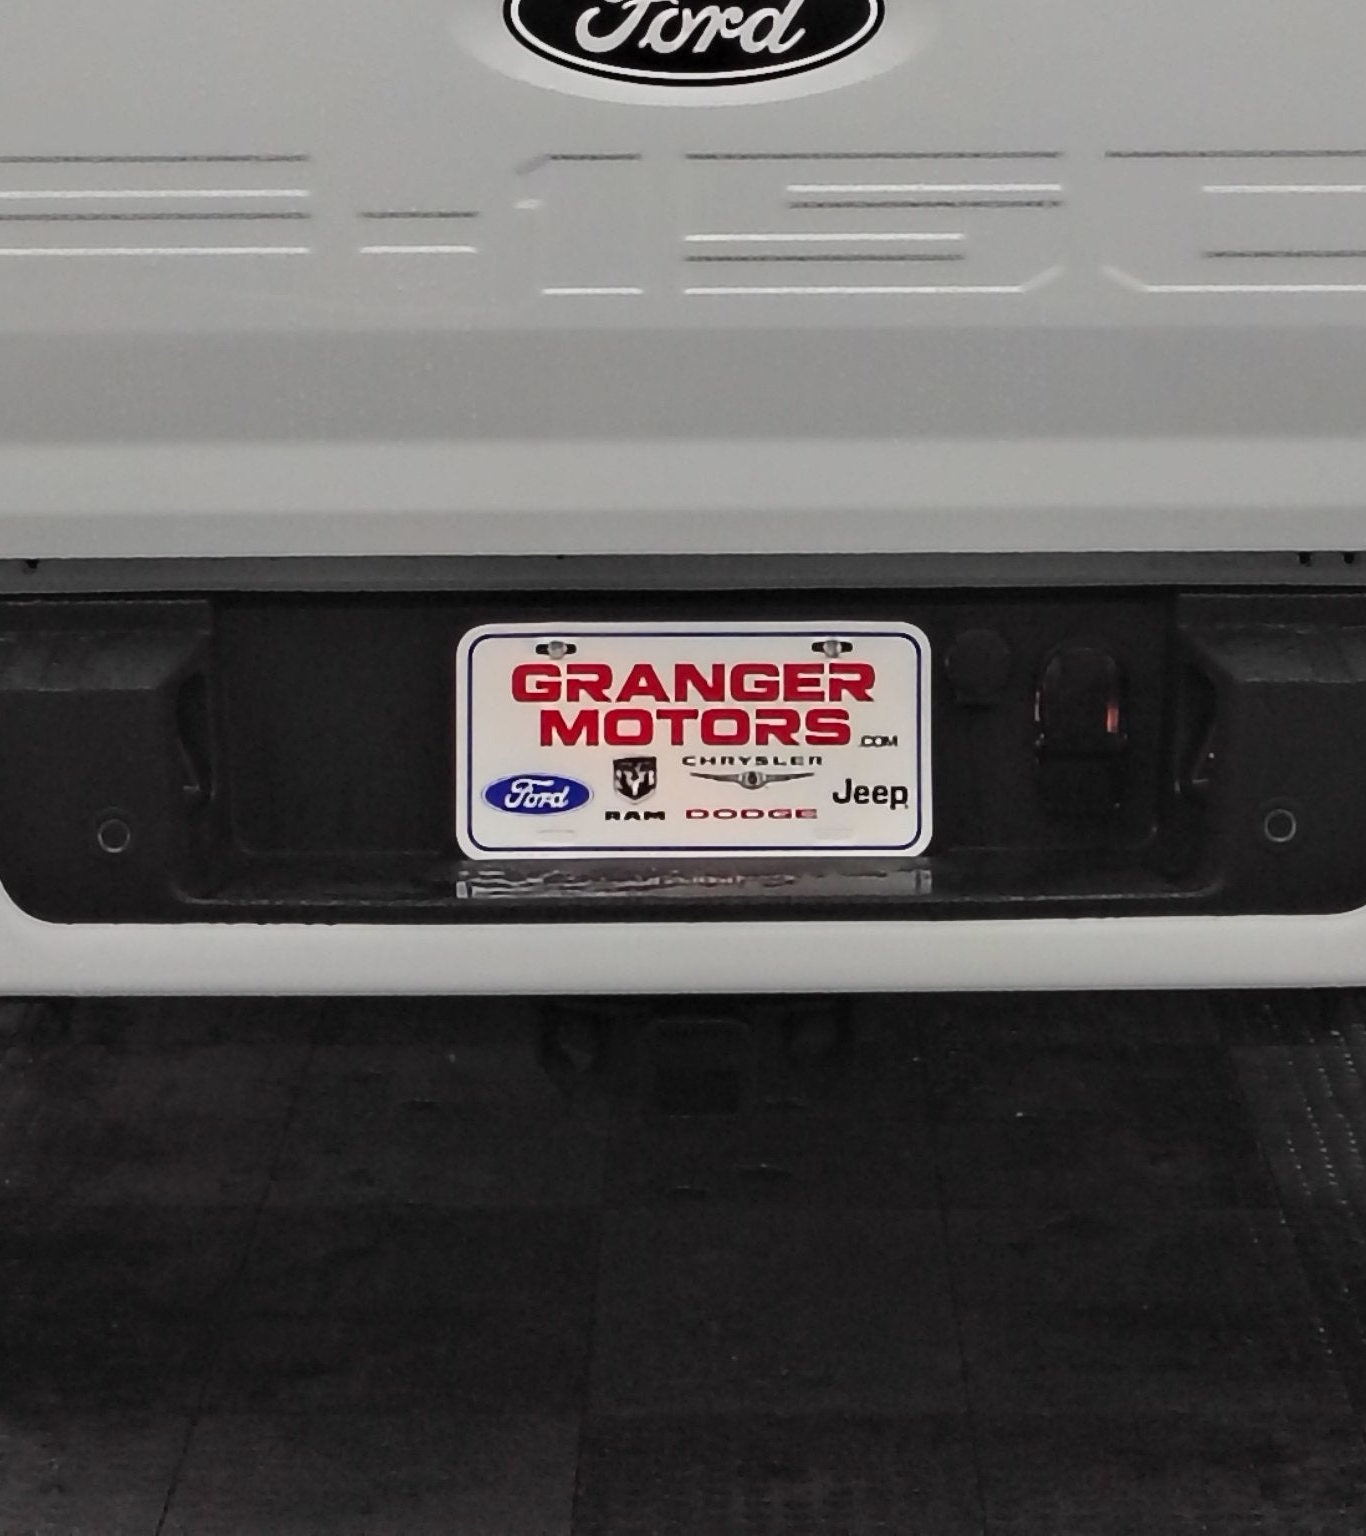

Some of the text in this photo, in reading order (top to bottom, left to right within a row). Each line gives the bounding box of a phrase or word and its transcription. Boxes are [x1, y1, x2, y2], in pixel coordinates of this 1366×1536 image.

[511, 662, 876, 703] GRANGER
[540, 708, 851, 747] MOTORS
[681, 755, 823, 767] CHRYSLER
[504, 778, 569, 809] Ford
[832, 778, 909, 810] Jeep
[604, 809, 666, 821] RAM
[685, 808, 819, 820] DODGE
